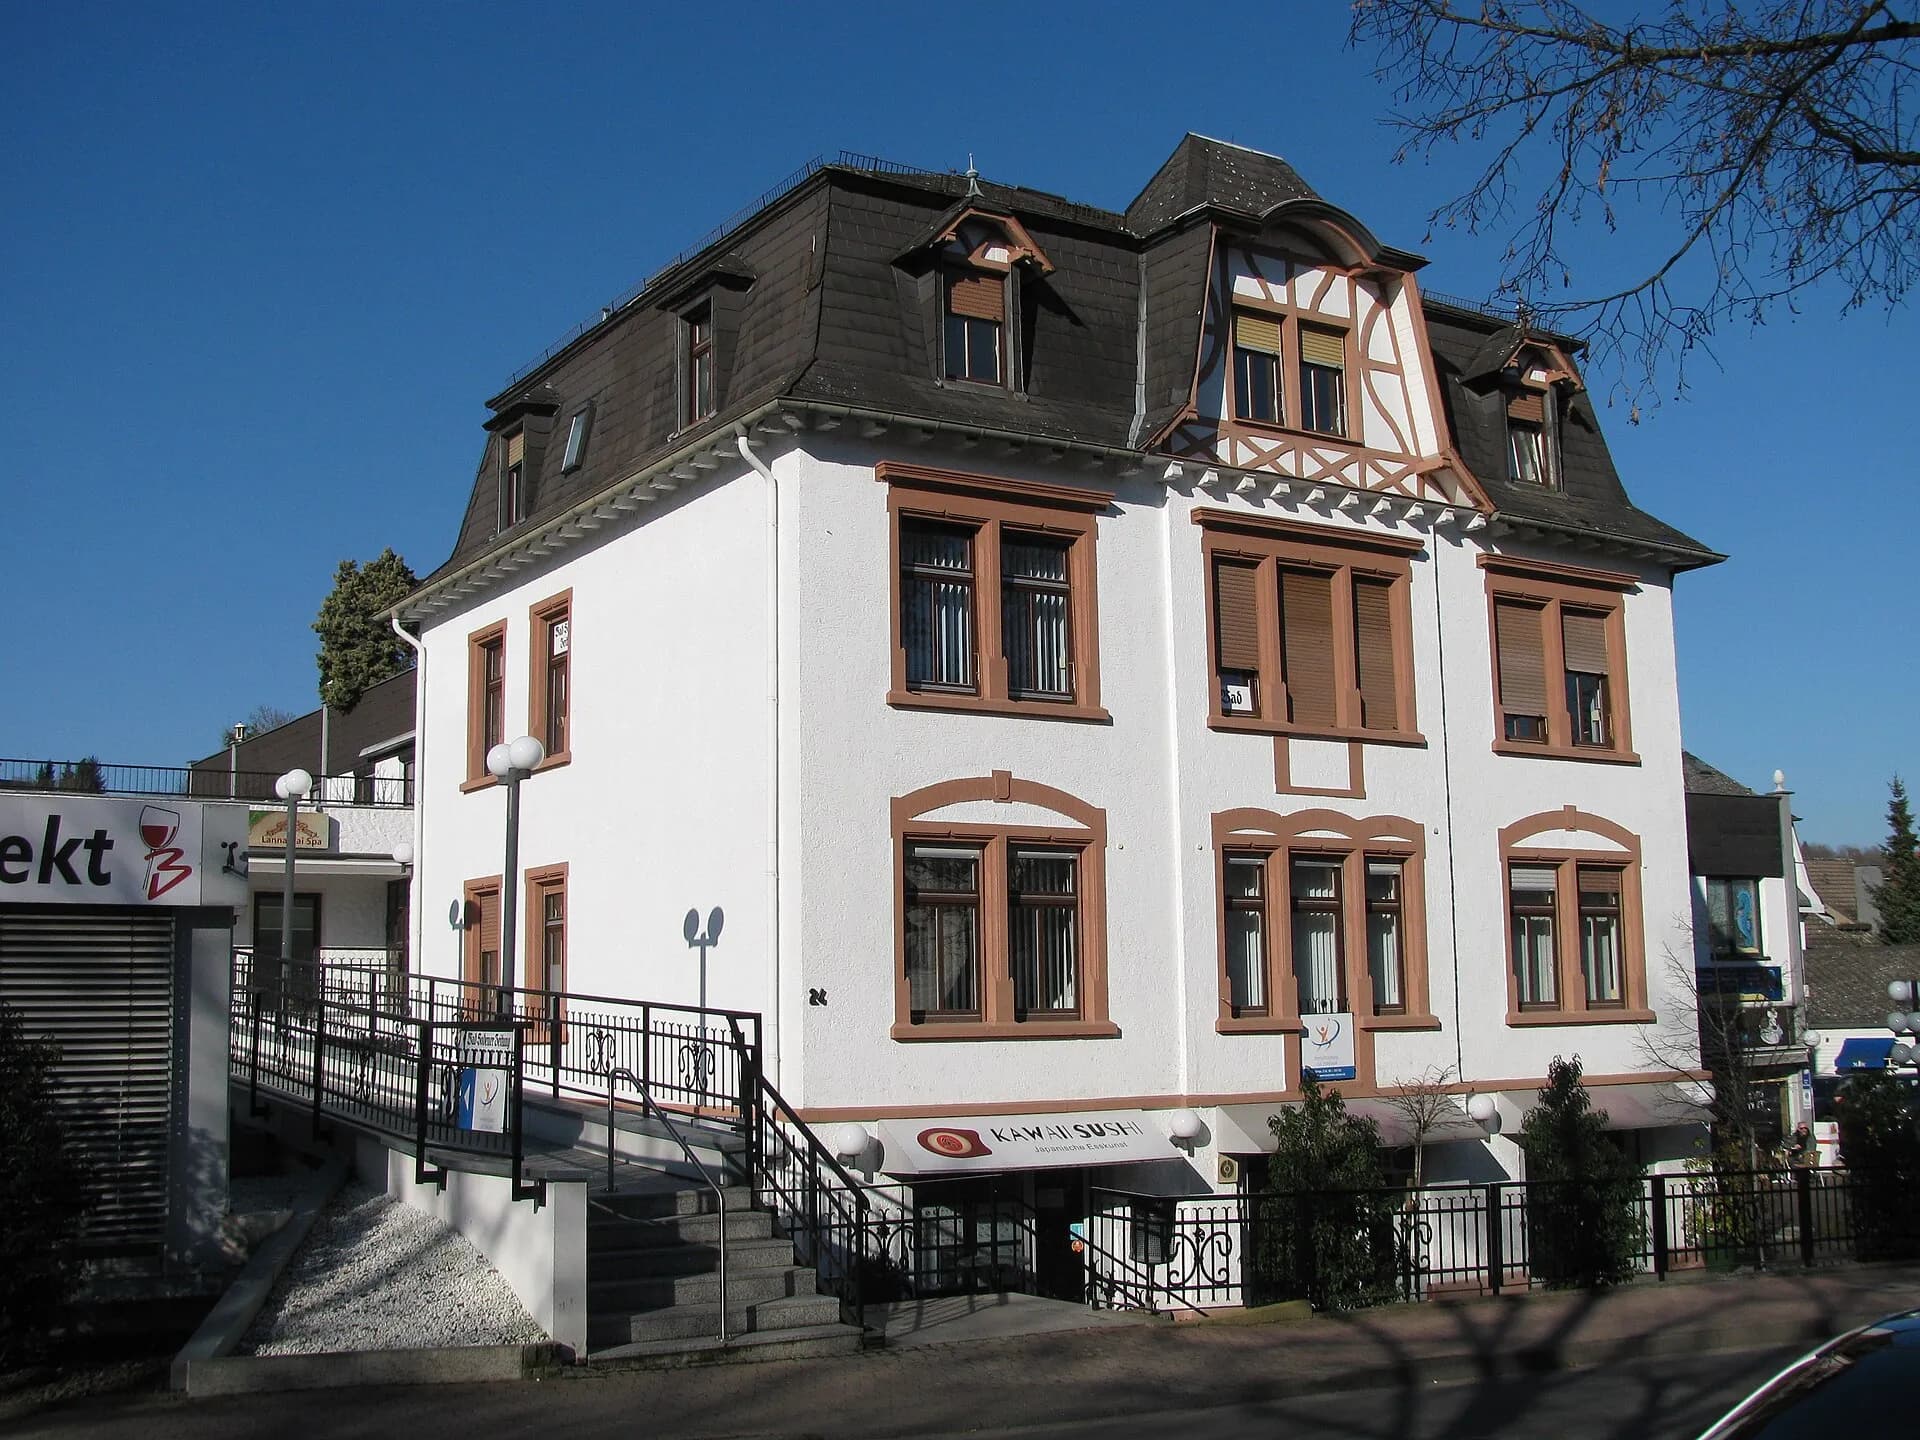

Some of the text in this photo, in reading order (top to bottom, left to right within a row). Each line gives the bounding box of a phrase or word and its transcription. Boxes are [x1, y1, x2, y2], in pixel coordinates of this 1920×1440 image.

[306, 836, 322, 847] Spa
[990, 1120, 1144, 1143] KAWAII SUSHI
[1034, 1141, 1128, 1154] Japanische Esskunst
